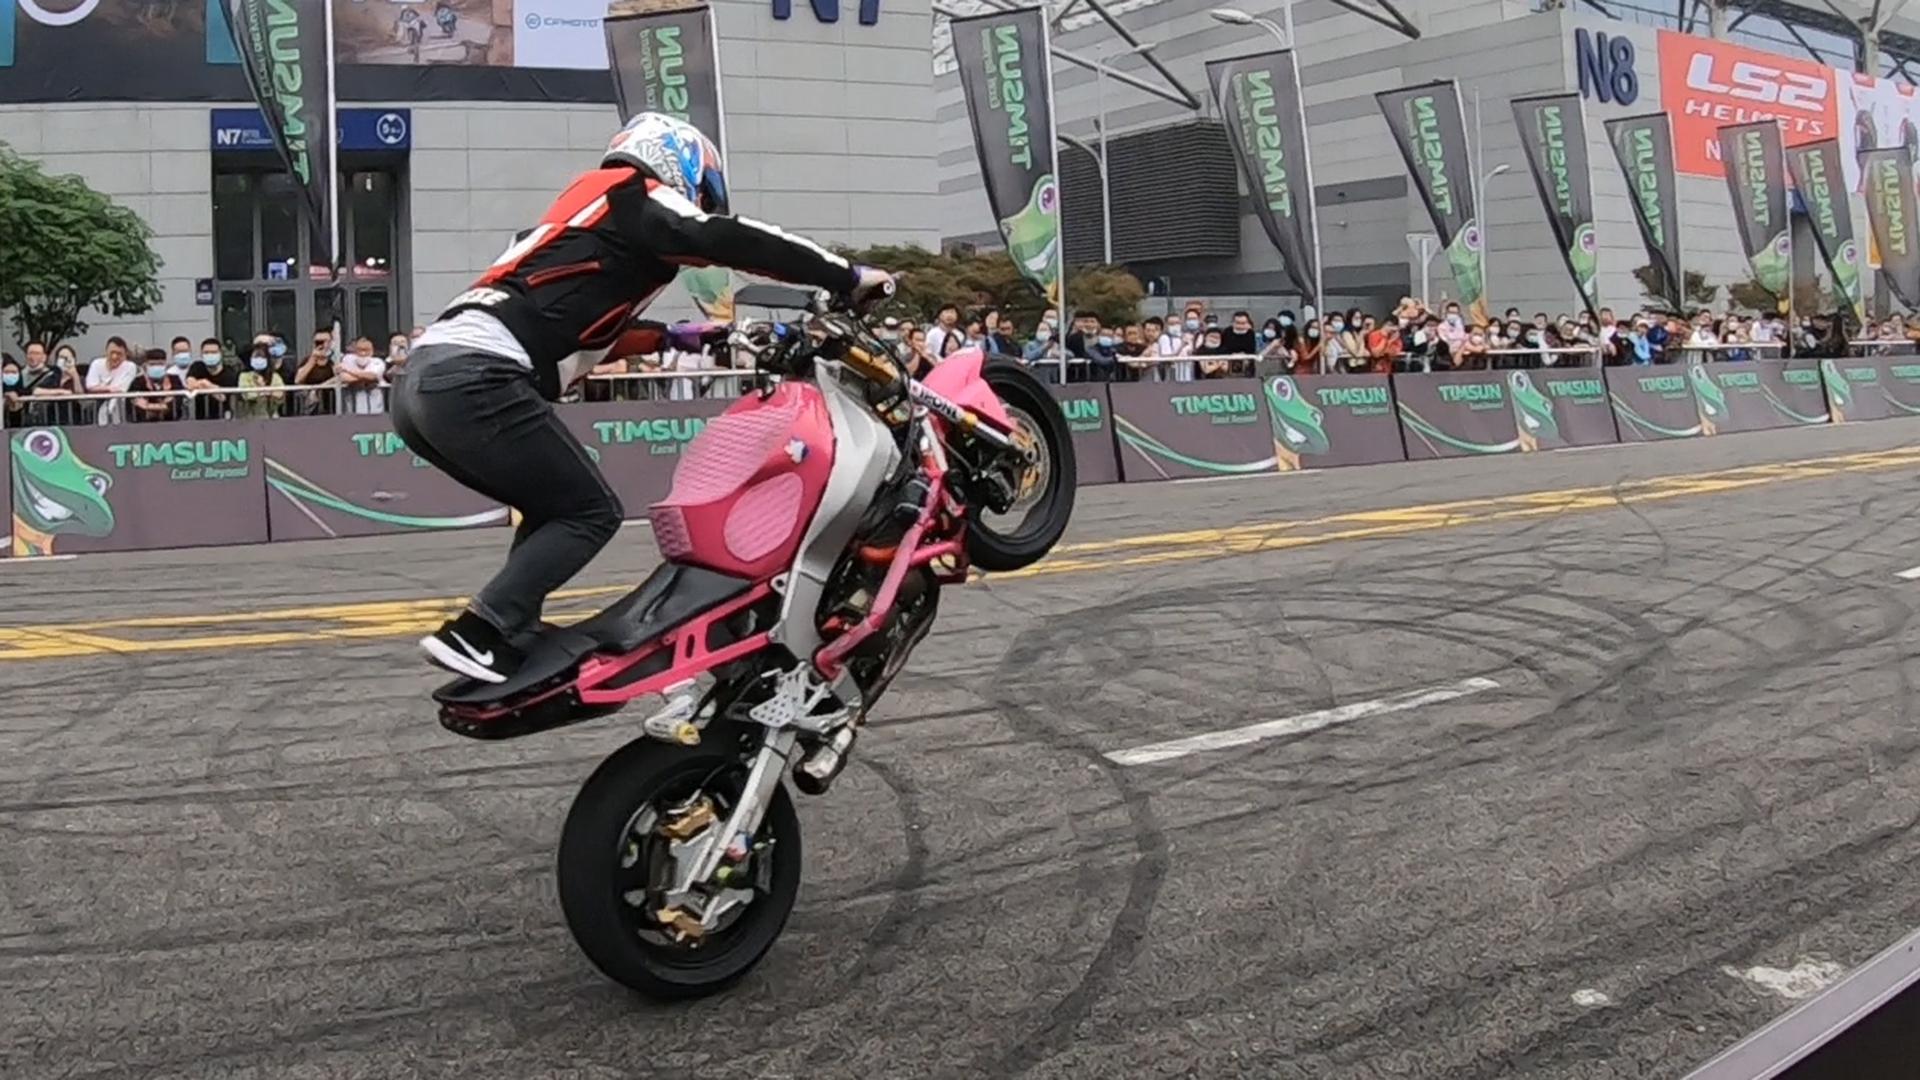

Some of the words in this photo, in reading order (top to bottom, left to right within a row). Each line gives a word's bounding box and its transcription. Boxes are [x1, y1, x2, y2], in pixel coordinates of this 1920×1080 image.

[1575, 27, 1639, 106] N8
[1686, 53, 1828, 112] LS2
[217, 129, 241, 145] N7
[1170, 393, 1256, 415] TIMSUN
[1316, 387, 1387, 406] TIMSUN
[1438, 383, 1502, 402] TIMSUN
[107, 438, 247, 468] TIMSUN
[351, 431, 406, 456] TIM
